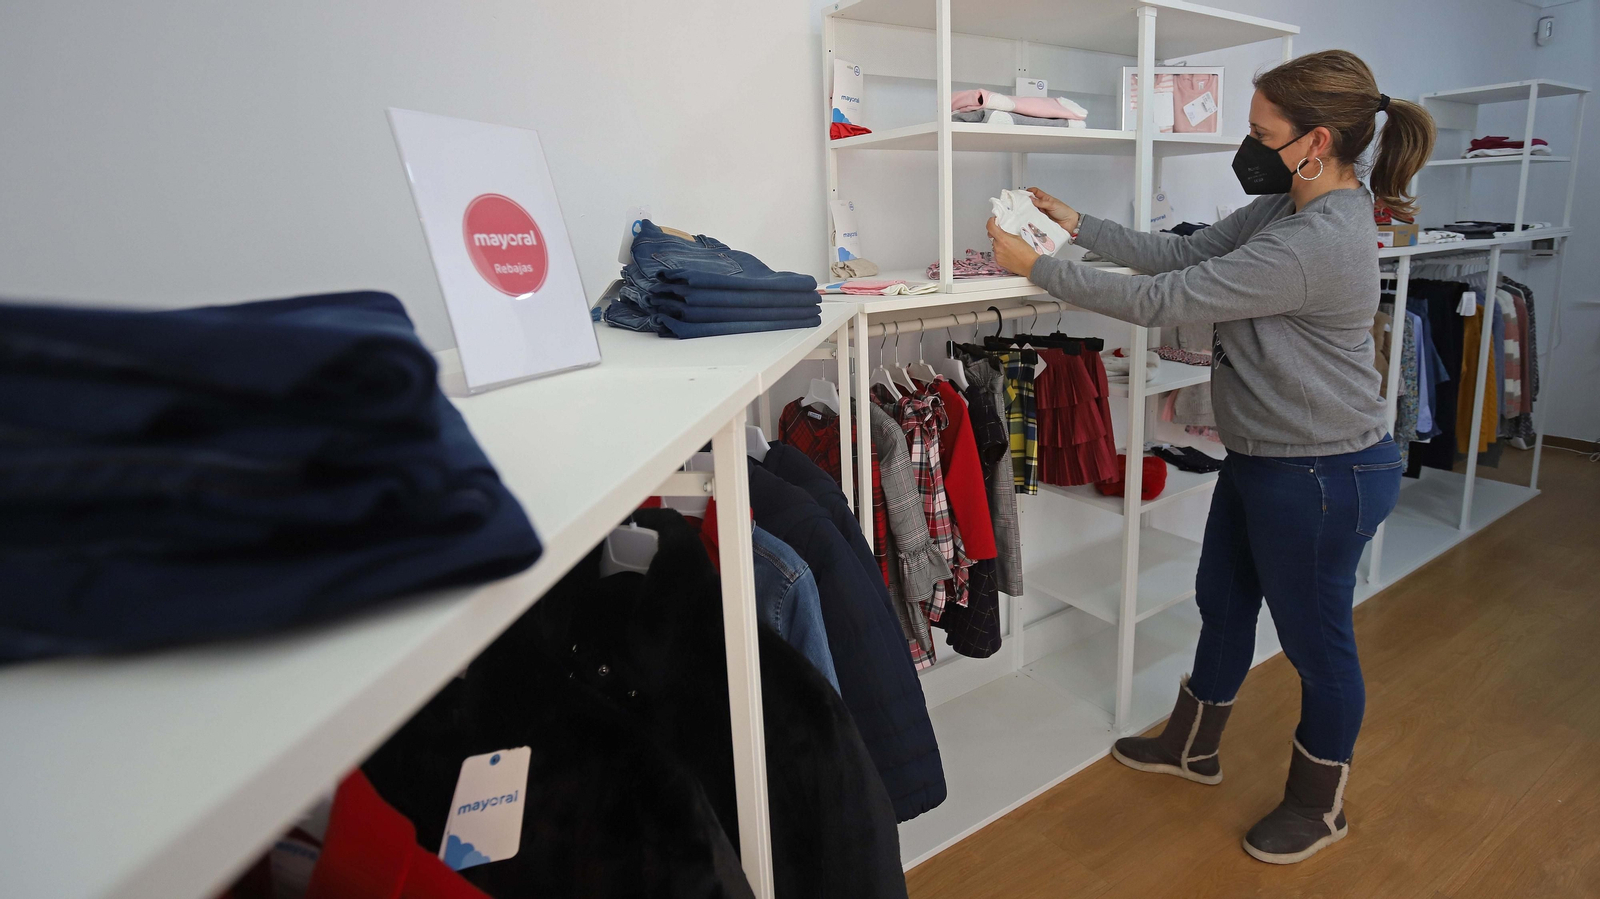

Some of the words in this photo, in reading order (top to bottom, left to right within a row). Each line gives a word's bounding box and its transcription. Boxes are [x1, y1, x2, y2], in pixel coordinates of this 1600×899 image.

[473, 230, 537, 250] mayoral
[494, 262, 534, 275] Rebajas
[458, 790, 518, 815] mayoral
